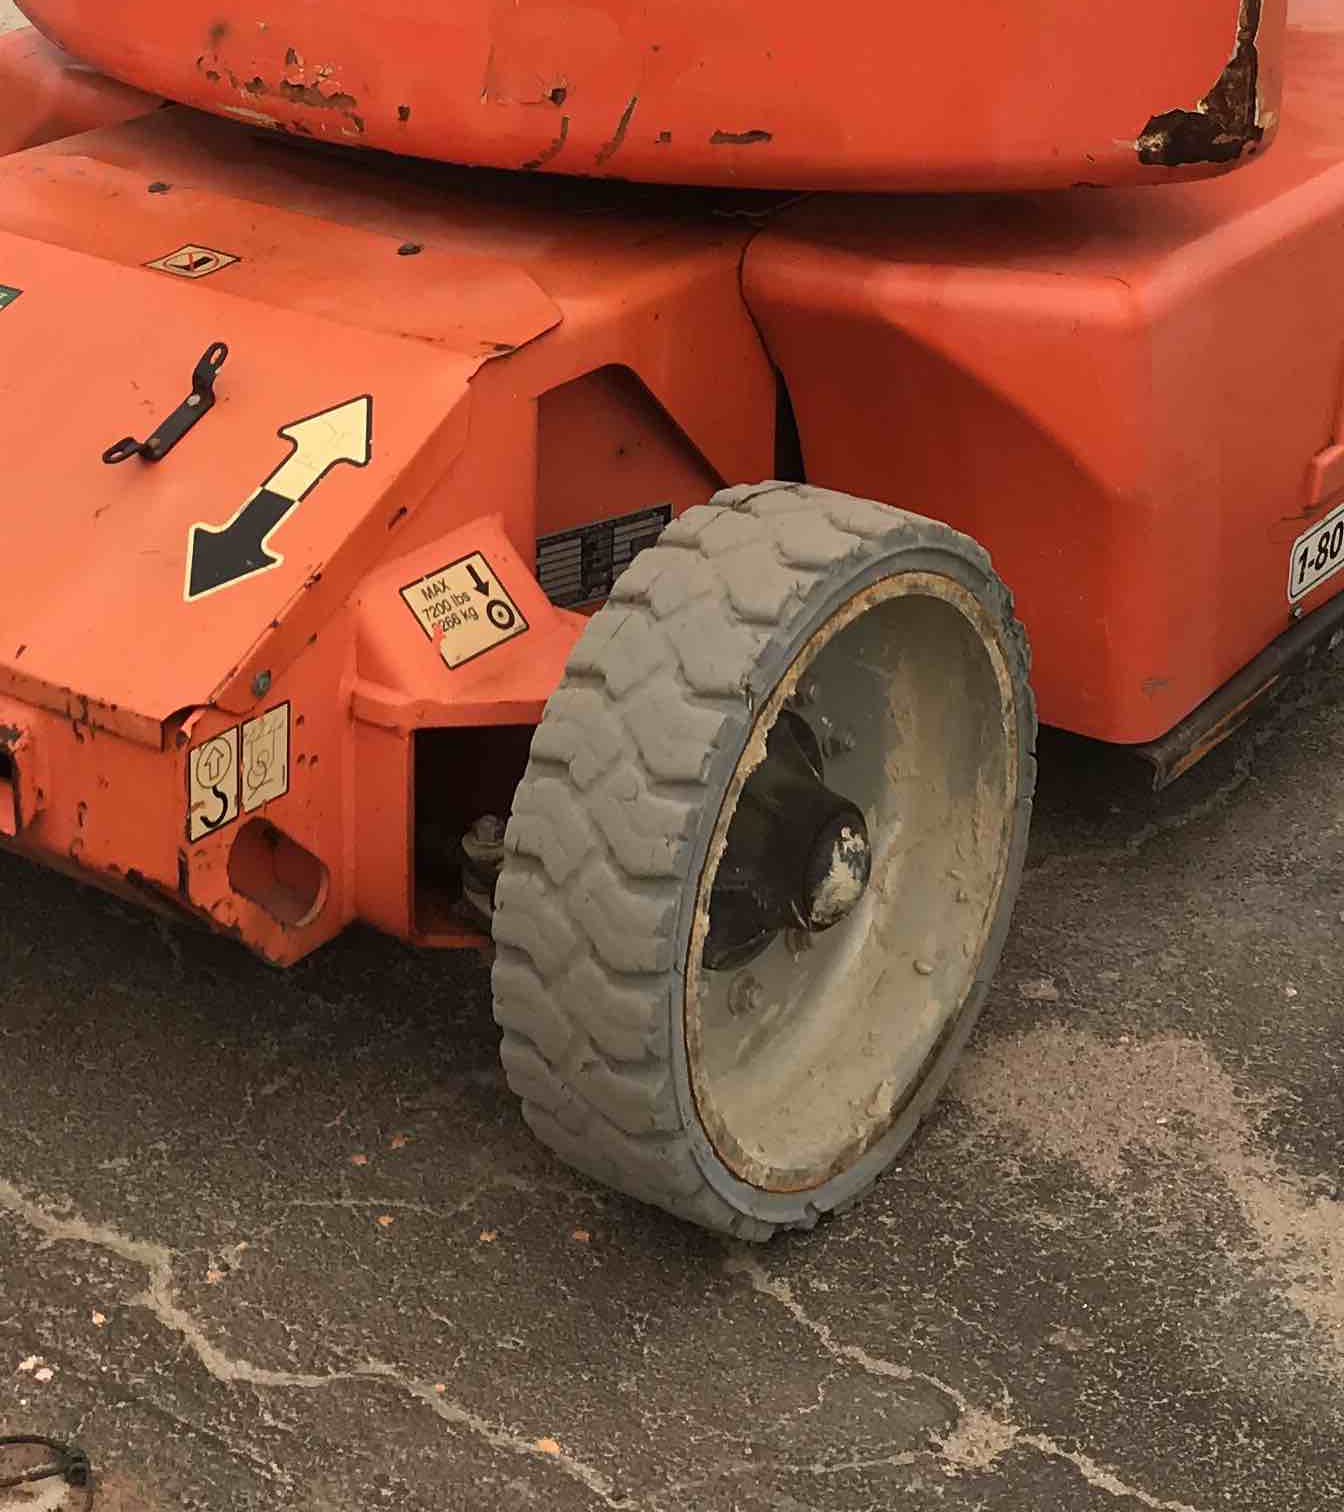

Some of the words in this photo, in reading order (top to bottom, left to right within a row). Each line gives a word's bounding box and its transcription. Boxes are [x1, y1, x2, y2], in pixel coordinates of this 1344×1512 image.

[421, 578, 451, 601] MAX
[422, 599, 452, 622] 7200
[450, 591, 472, 608] lbs
